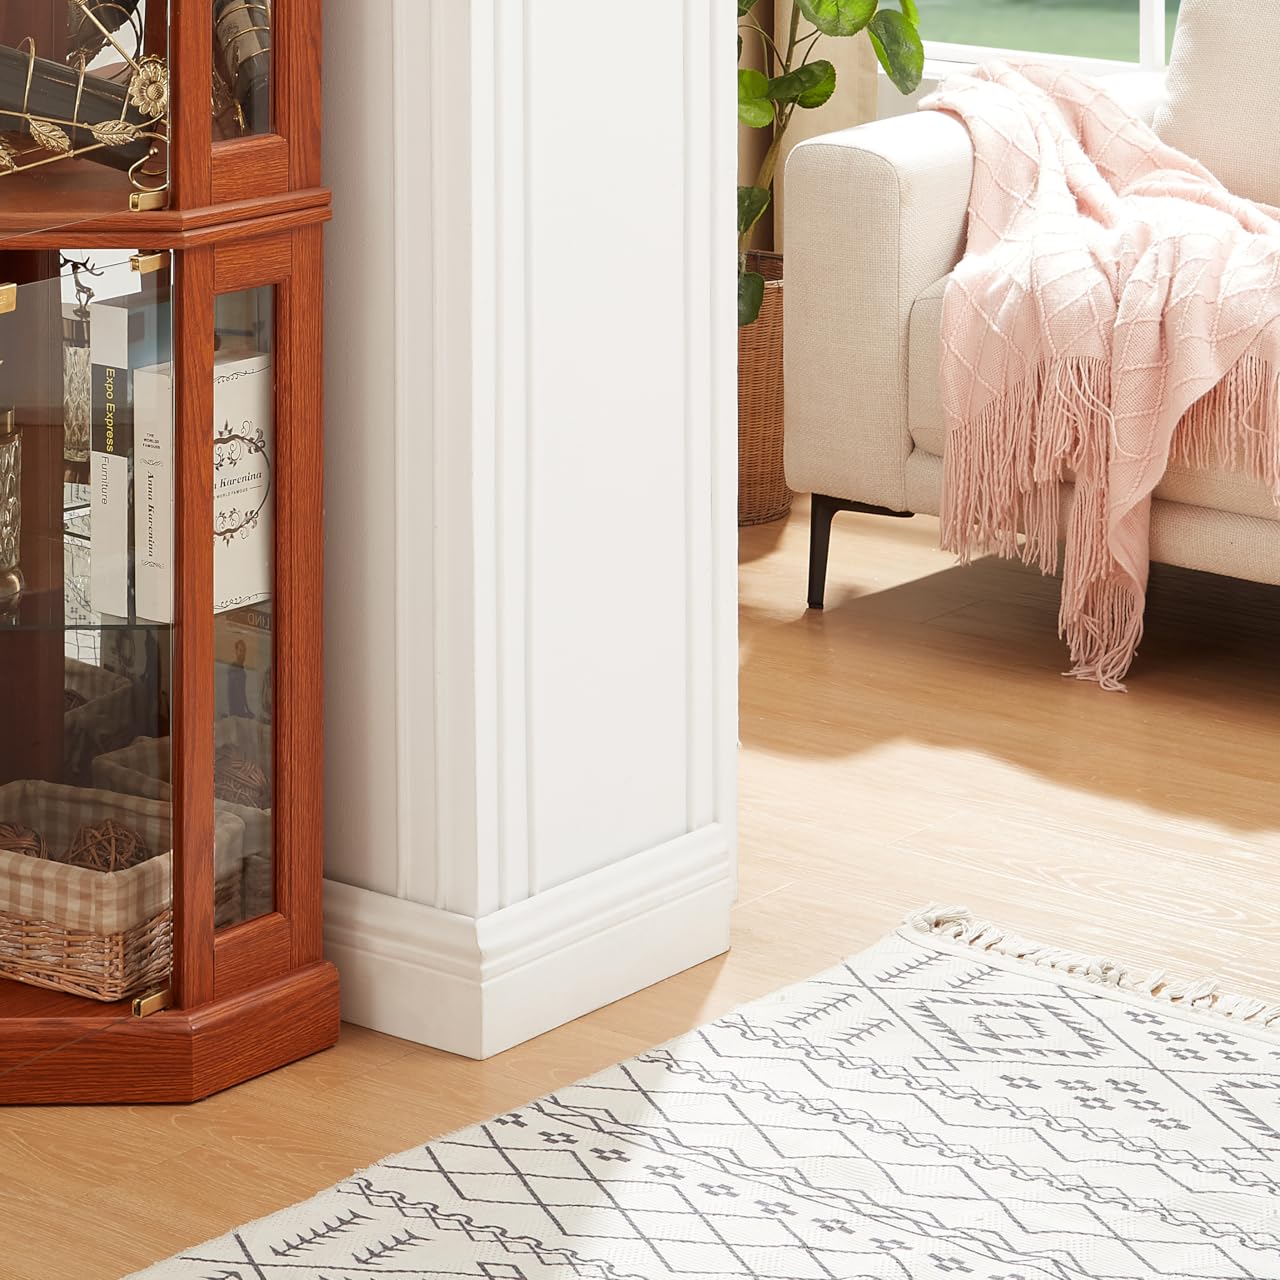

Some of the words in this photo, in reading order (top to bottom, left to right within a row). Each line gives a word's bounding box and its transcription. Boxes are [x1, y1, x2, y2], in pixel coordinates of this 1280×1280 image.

[104, 368, 115, 399] Expo
[104, 403, 115, 452] Express
[101, 456, 109, 505] Furniture
[147, 471, 155, 501] Anna
[220, 472, 262, 488] Karenina
[147, 504, 155, 557] Karenina
